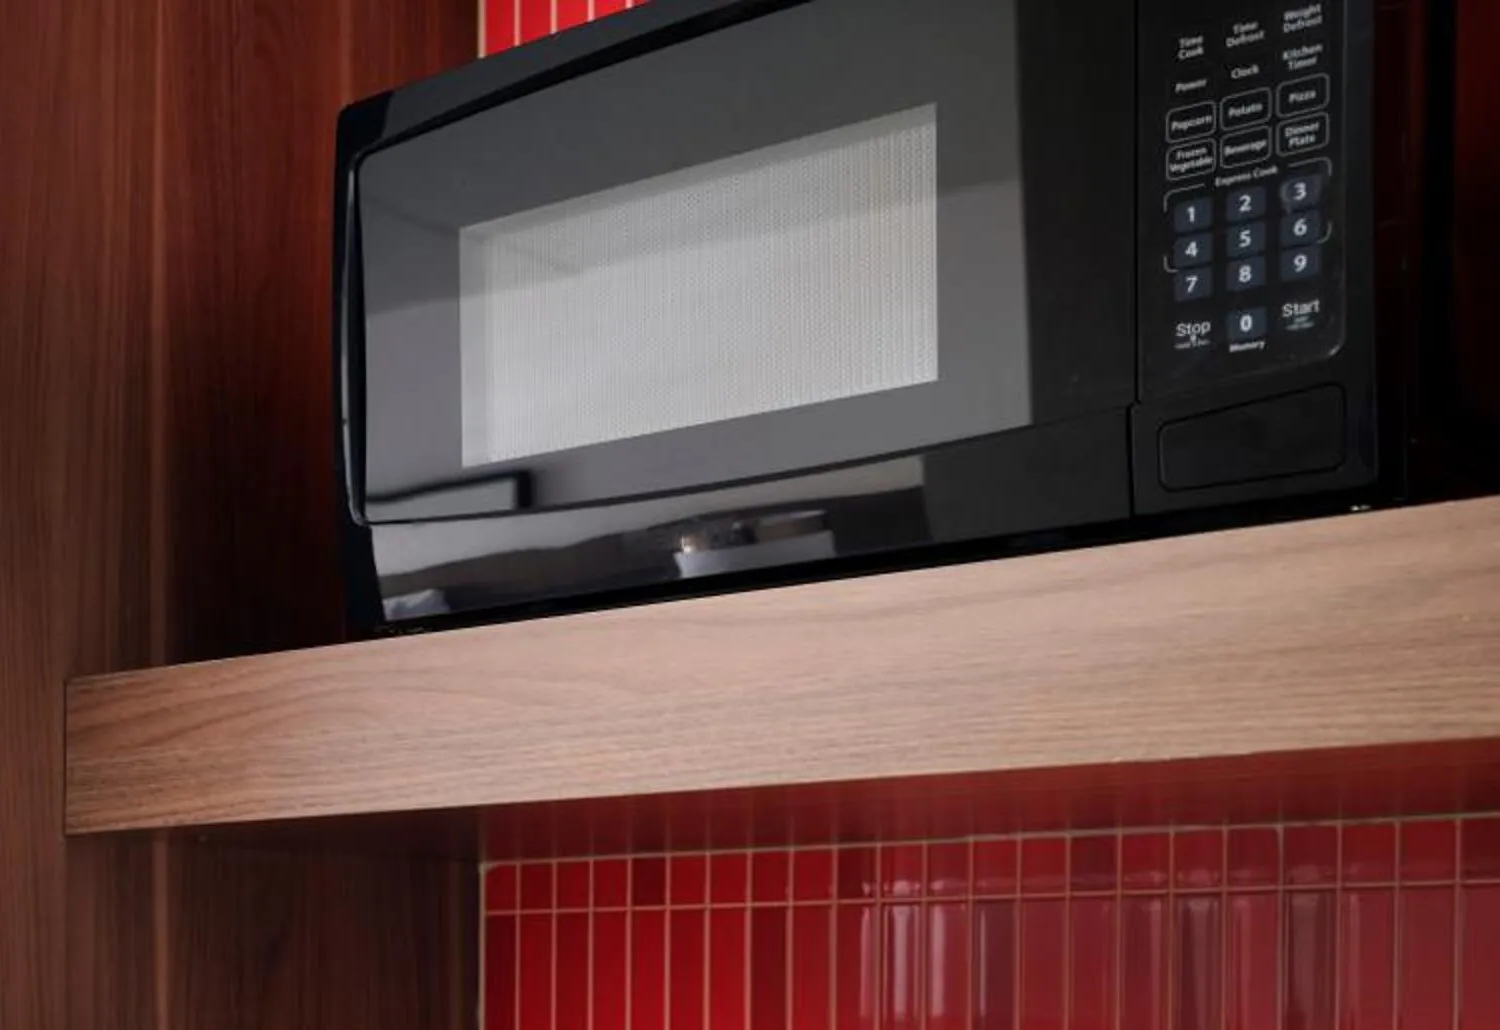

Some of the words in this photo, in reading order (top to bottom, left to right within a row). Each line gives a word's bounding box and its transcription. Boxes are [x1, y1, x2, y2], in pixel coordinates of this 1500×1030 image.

[1226, 30, 1265, 47] Defrost
[1231, 64, 1260, 79] Clock
[1288, 56, 1318, 70] Timer
[1289, 90, 1317, 103] Pizza
[1295, 182, 1307, 200] 3
[1239, 195, 1252, 212] 2
[1187, 207, 1195, 222] 1
[1293, 218, 1307, 236] 6
[1239, 230, 1251, 248] 5
[1185, 241, 1198, 257] 4
[1294, 255, 1307, 273] 9
[1238, 265, 1252, 283] 8
[1185, 276, 1198, 293] 7
[1282, 299, 1320, 318] Start
[1175, 321, 1211, 338] Stop
[1239, 315, 1253, 332] 0
